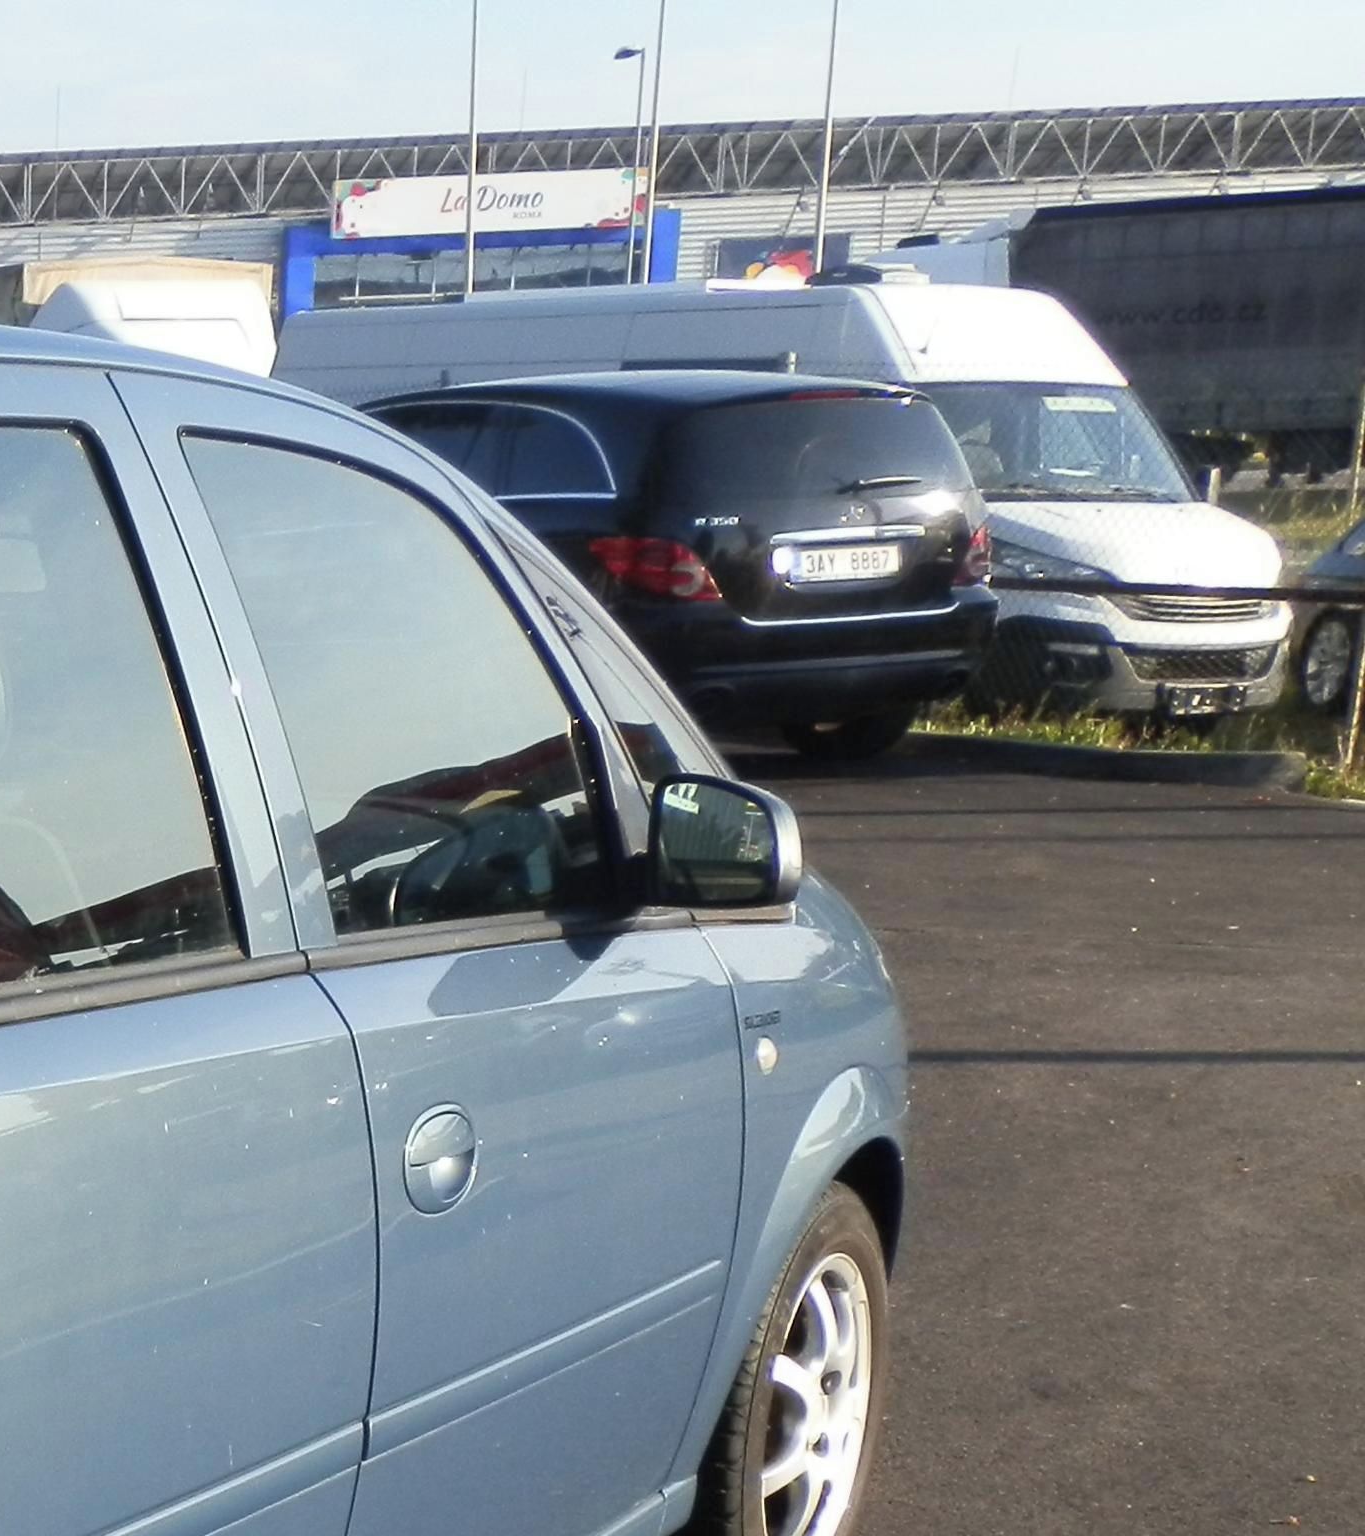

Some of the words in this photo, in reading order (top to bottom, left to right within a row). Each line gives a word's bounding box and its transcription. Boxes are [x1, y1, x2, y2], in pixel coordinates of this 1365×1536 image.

[440, 187, 469, 213] La
[476, 185, 544, 212] Domo
[805, 553, 836, 574] 3AY
